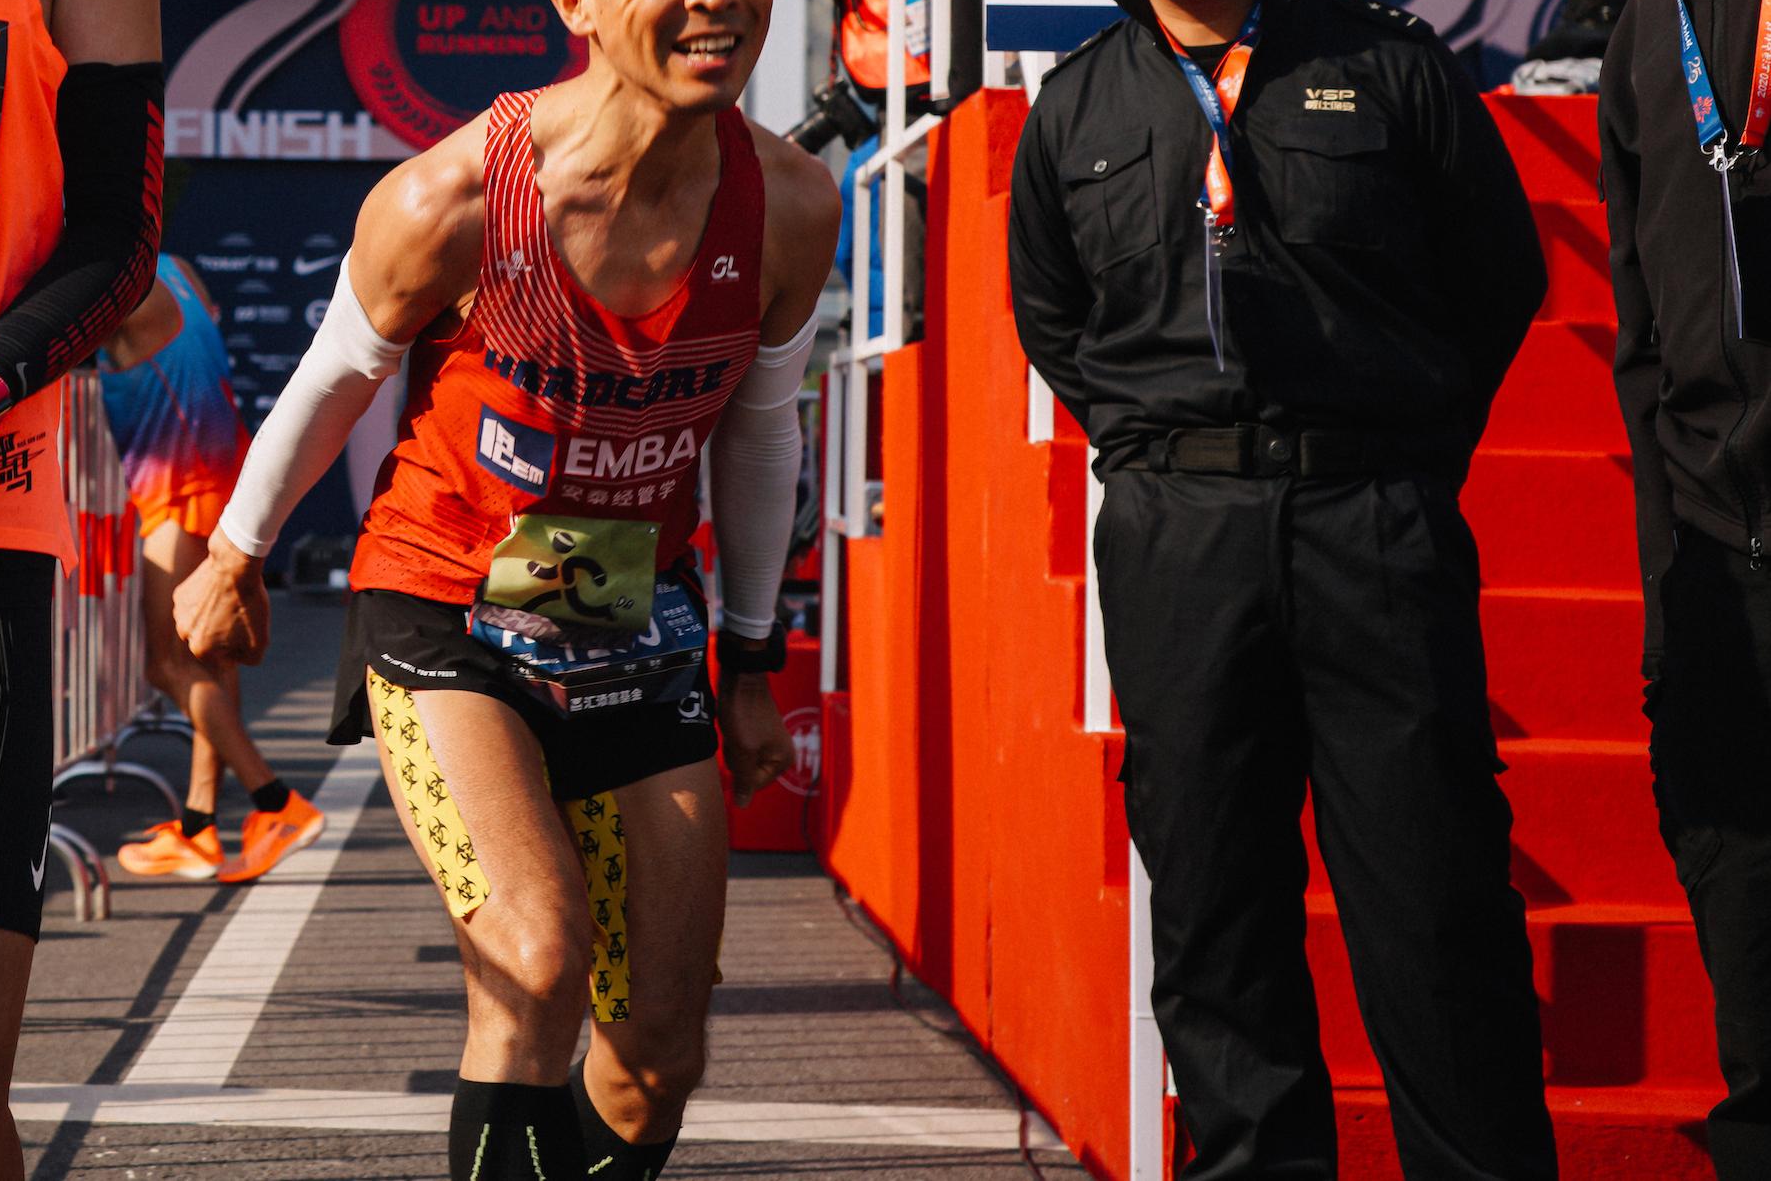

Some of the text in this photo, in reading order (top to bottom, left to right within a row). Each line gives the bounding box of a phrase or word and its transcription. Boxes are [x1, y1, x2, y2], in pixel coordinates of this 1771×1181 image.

[417, 4, 548, 32] UP AND
[416, 33, 548, 56] RUNNING
[1305, 88, 1356, 101] VSP
[164, 109, 374, 159] FINISH
[484, 348, 731, 410] HARDCORE
[564, 427, 697, 479] EMBA
